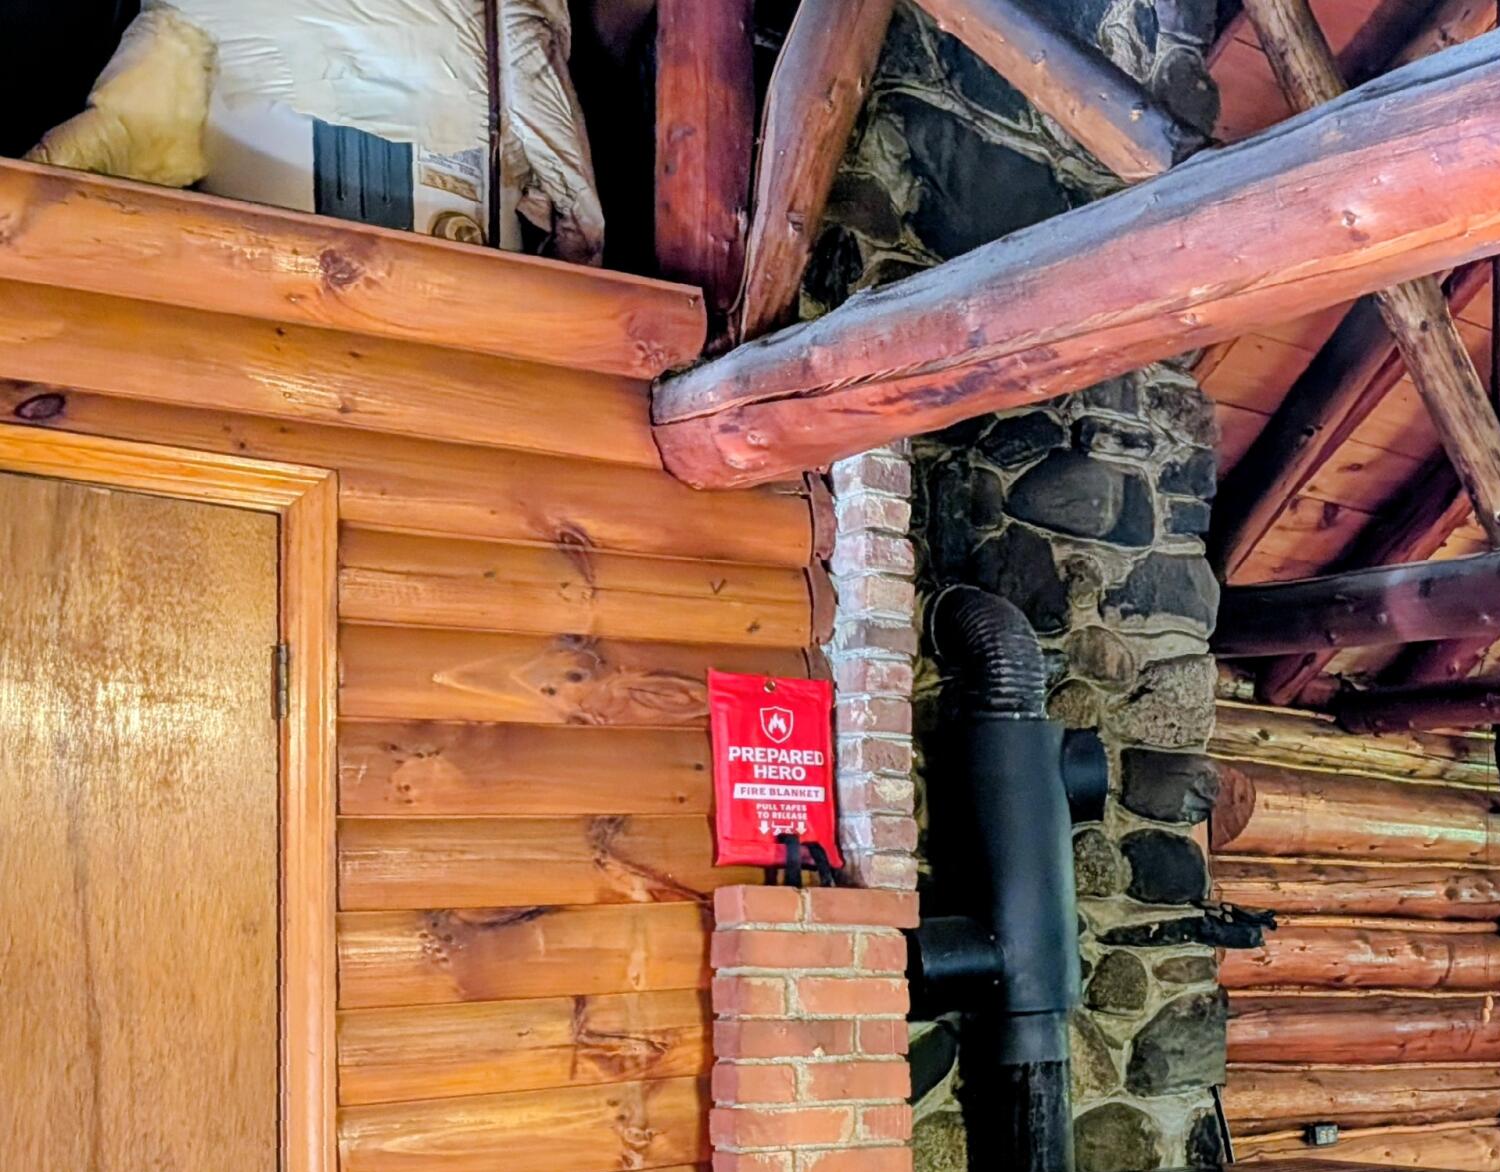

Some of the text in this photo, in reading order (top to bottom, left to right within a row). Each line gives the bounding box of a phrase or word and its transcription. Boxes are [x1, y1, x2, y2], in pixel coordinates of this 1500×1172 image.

[728, 746, 825, 766] PREPARED
[754, 764, 806, 781] HERO
[740, 786, 820, 799] FIRE BLANKET
[756, 803, 778, 811] PULL
[757, 811, 770, 819] TO
